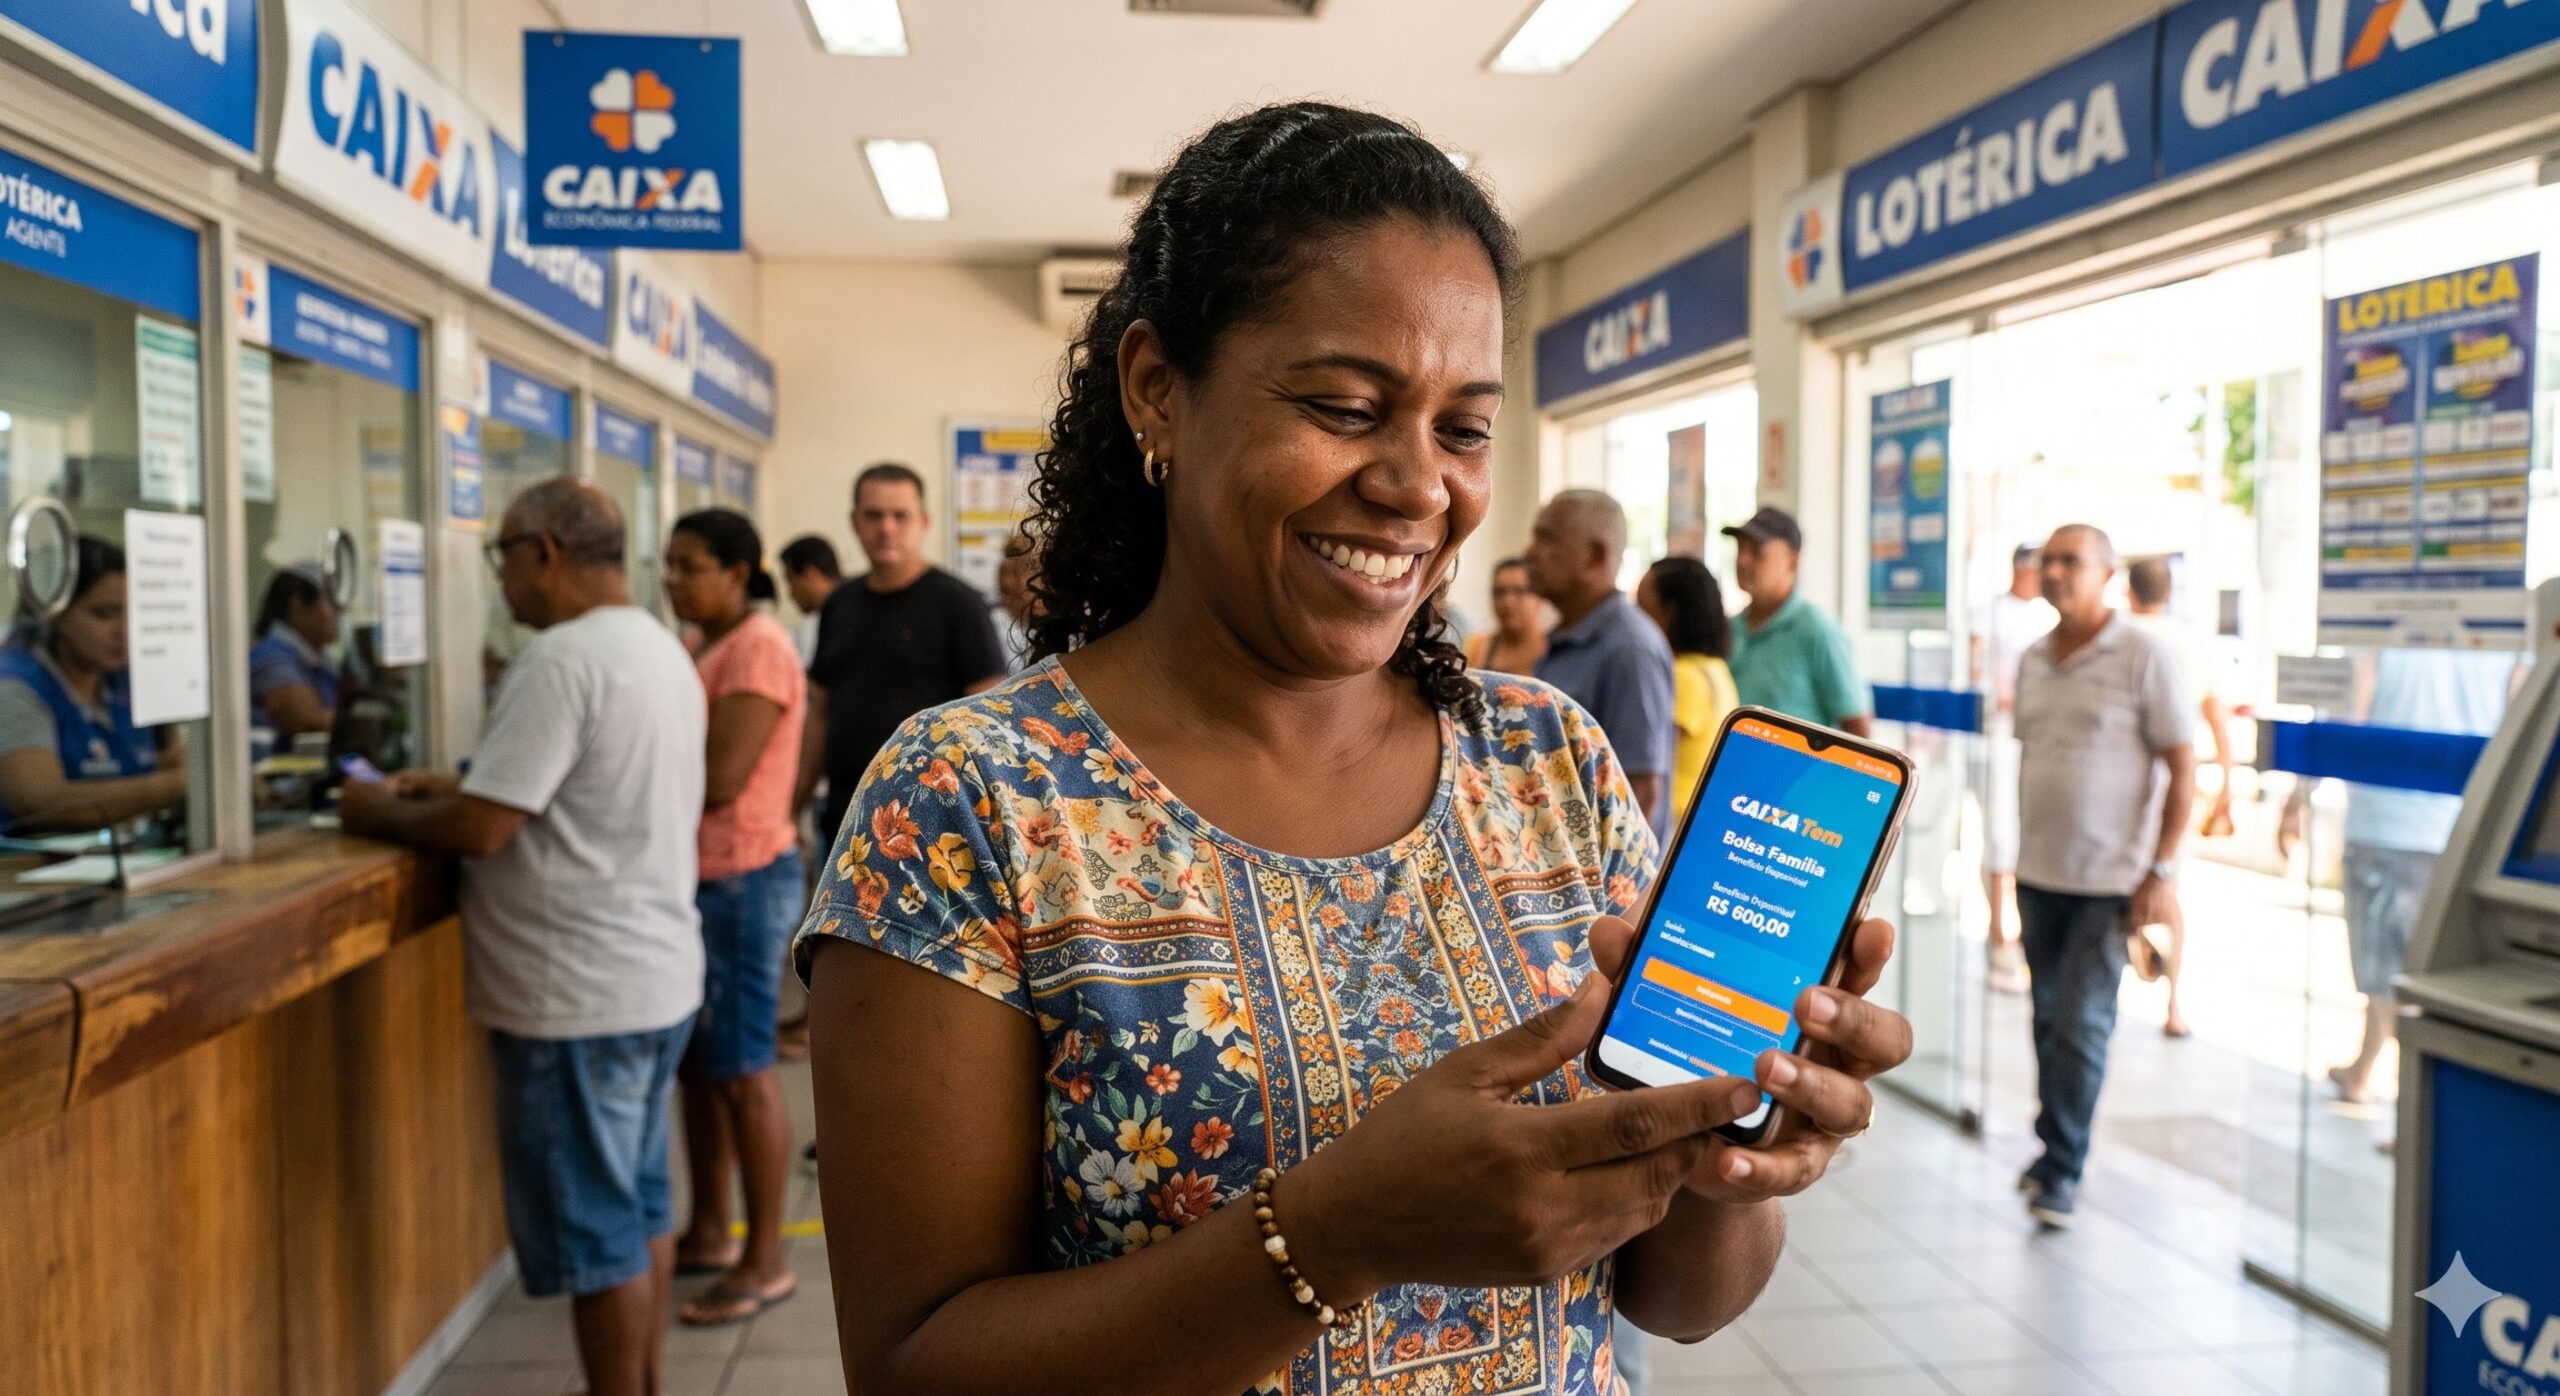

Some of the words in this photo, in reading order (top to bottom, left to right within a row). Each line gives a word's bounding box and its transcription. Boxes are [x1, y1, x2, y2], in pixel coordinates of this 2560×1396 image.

[308, 28, 481, 239] CAIXA
[542, 164, 723, 213] CAIXA
[1855, 81, 2129, 259] LOTÉRICA
[1584, 290, 1671, 374] CAIXA
[1722, 829, 1766, 857] Bolsa
[1730, 795, 1801, 833] CAIXA
[1801, 818, 1844, 848] Tem
[1731, 904, 1791, 939] 600,00
